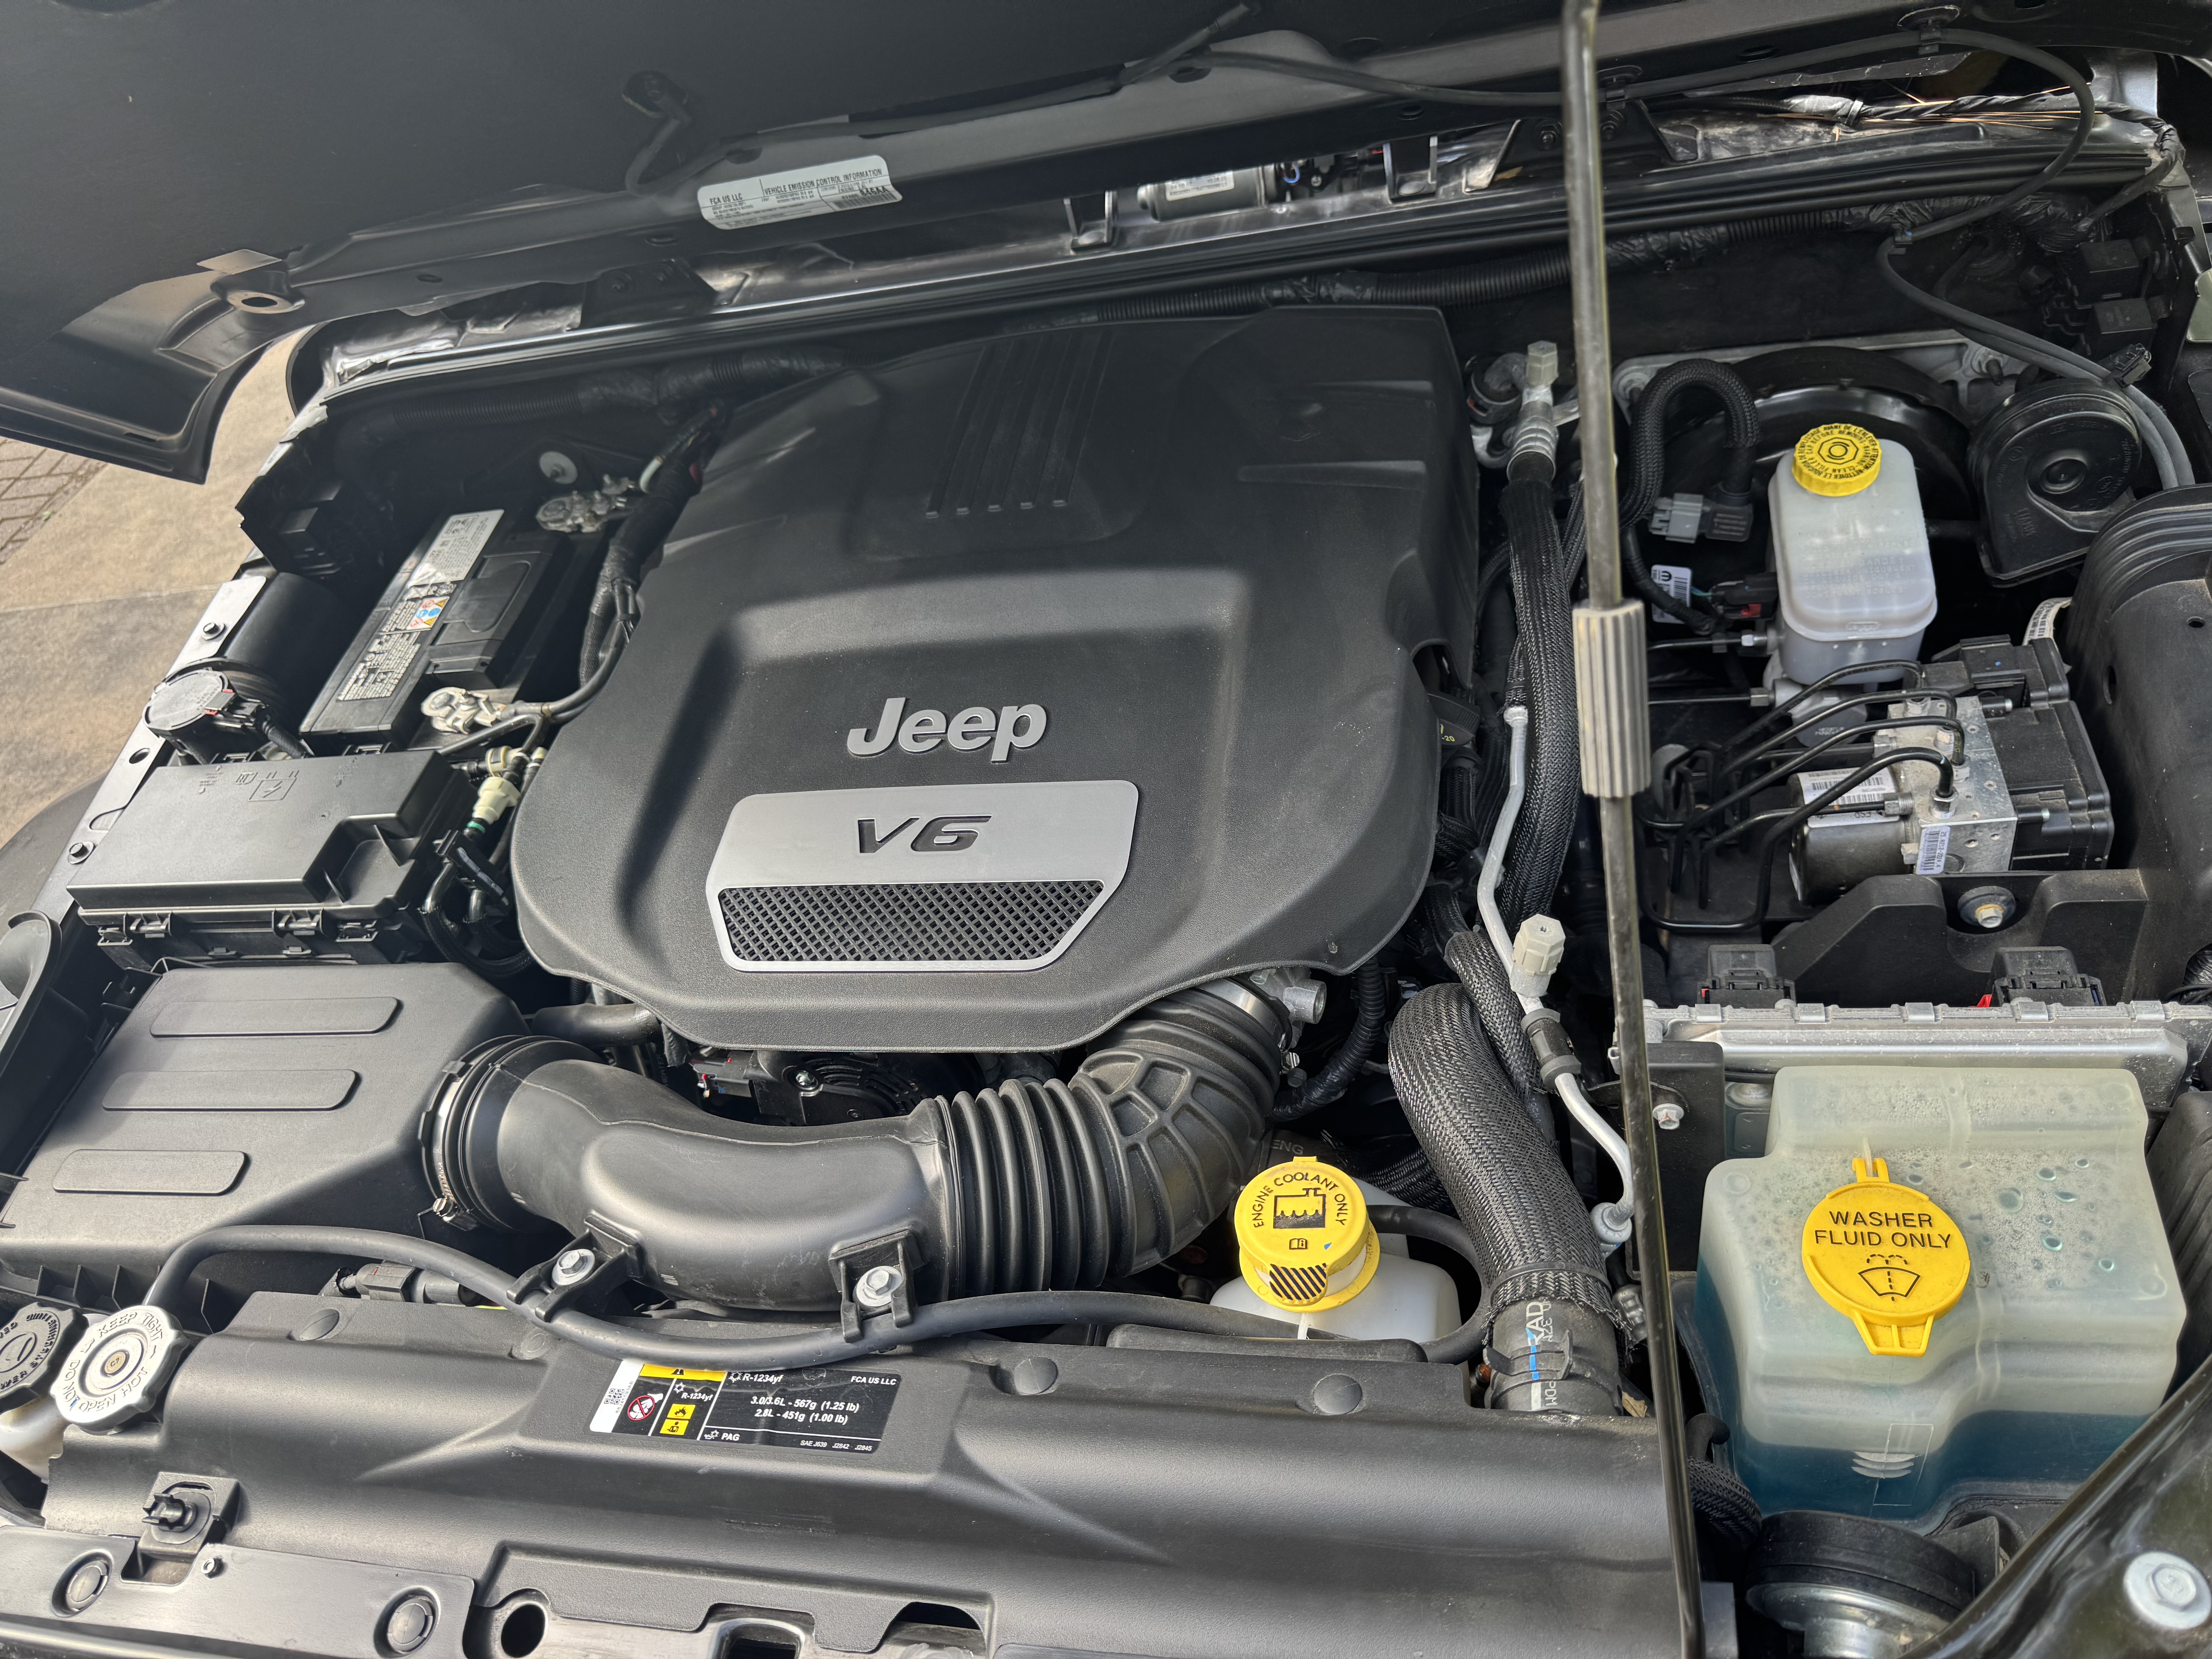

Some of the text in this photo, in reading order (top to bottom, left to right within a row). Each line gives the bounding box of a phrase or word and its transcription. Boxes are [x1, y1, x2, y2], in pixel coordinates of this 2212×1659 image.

[764, 185, 787, 195] VEHICLE
[788, 180, 816, 191] EMISSION
[816, 176, 842, 186] CONTROL
[843, 168, 883, 181] INFORMATION
[732, 193, 743, 201] LLC
[1810, 430, 1834, 445] BEFORE
[1807, 457, 1829, 472] FILLER
[1832, 465, 1856, 474] CLEAN
[847, 697, 1047, 764] Jeep
[857, 814, 993, 853] V6
[1251, 1172, 1349, 1228] ENGINE COOLANT ONLY
[1829, 1211, 1933, 1228] WASHER
[1814, 1230, 1951, 1249] FLUID ONLY
[97, 1312, 163, 1341] KEEP TIGHT
[1526, 1301, 1545, 1346] RAD
[110, 1357, 120, 1368] C7
[65, 1360, 81, 1381] DO
[79, 1394, 116, 1413] OPEN
[120, 1366, 148, 1398] HOT
[742, 1373, 784, 1385] R-1234yf
[880, 1377, 898, 1386] LLC
[680, 1392, 714, 1402] R-1234yf
[750, 1396, 786, 1407] 3.0/3.6L
[793, 1399, 817, 1410] 567g
[820, 1400, 845, 1412] (1.25
[845, 1402, 860, 1414] lb)
[754, 1408, 774, 1418] 2.8L
[781, 1411, 805, 1422] 451g
[809, 1412, 833, 1423] (1.00
[834, 1414, 848, 1426] lb)
[721, 1433, 740, 1441] PAG
